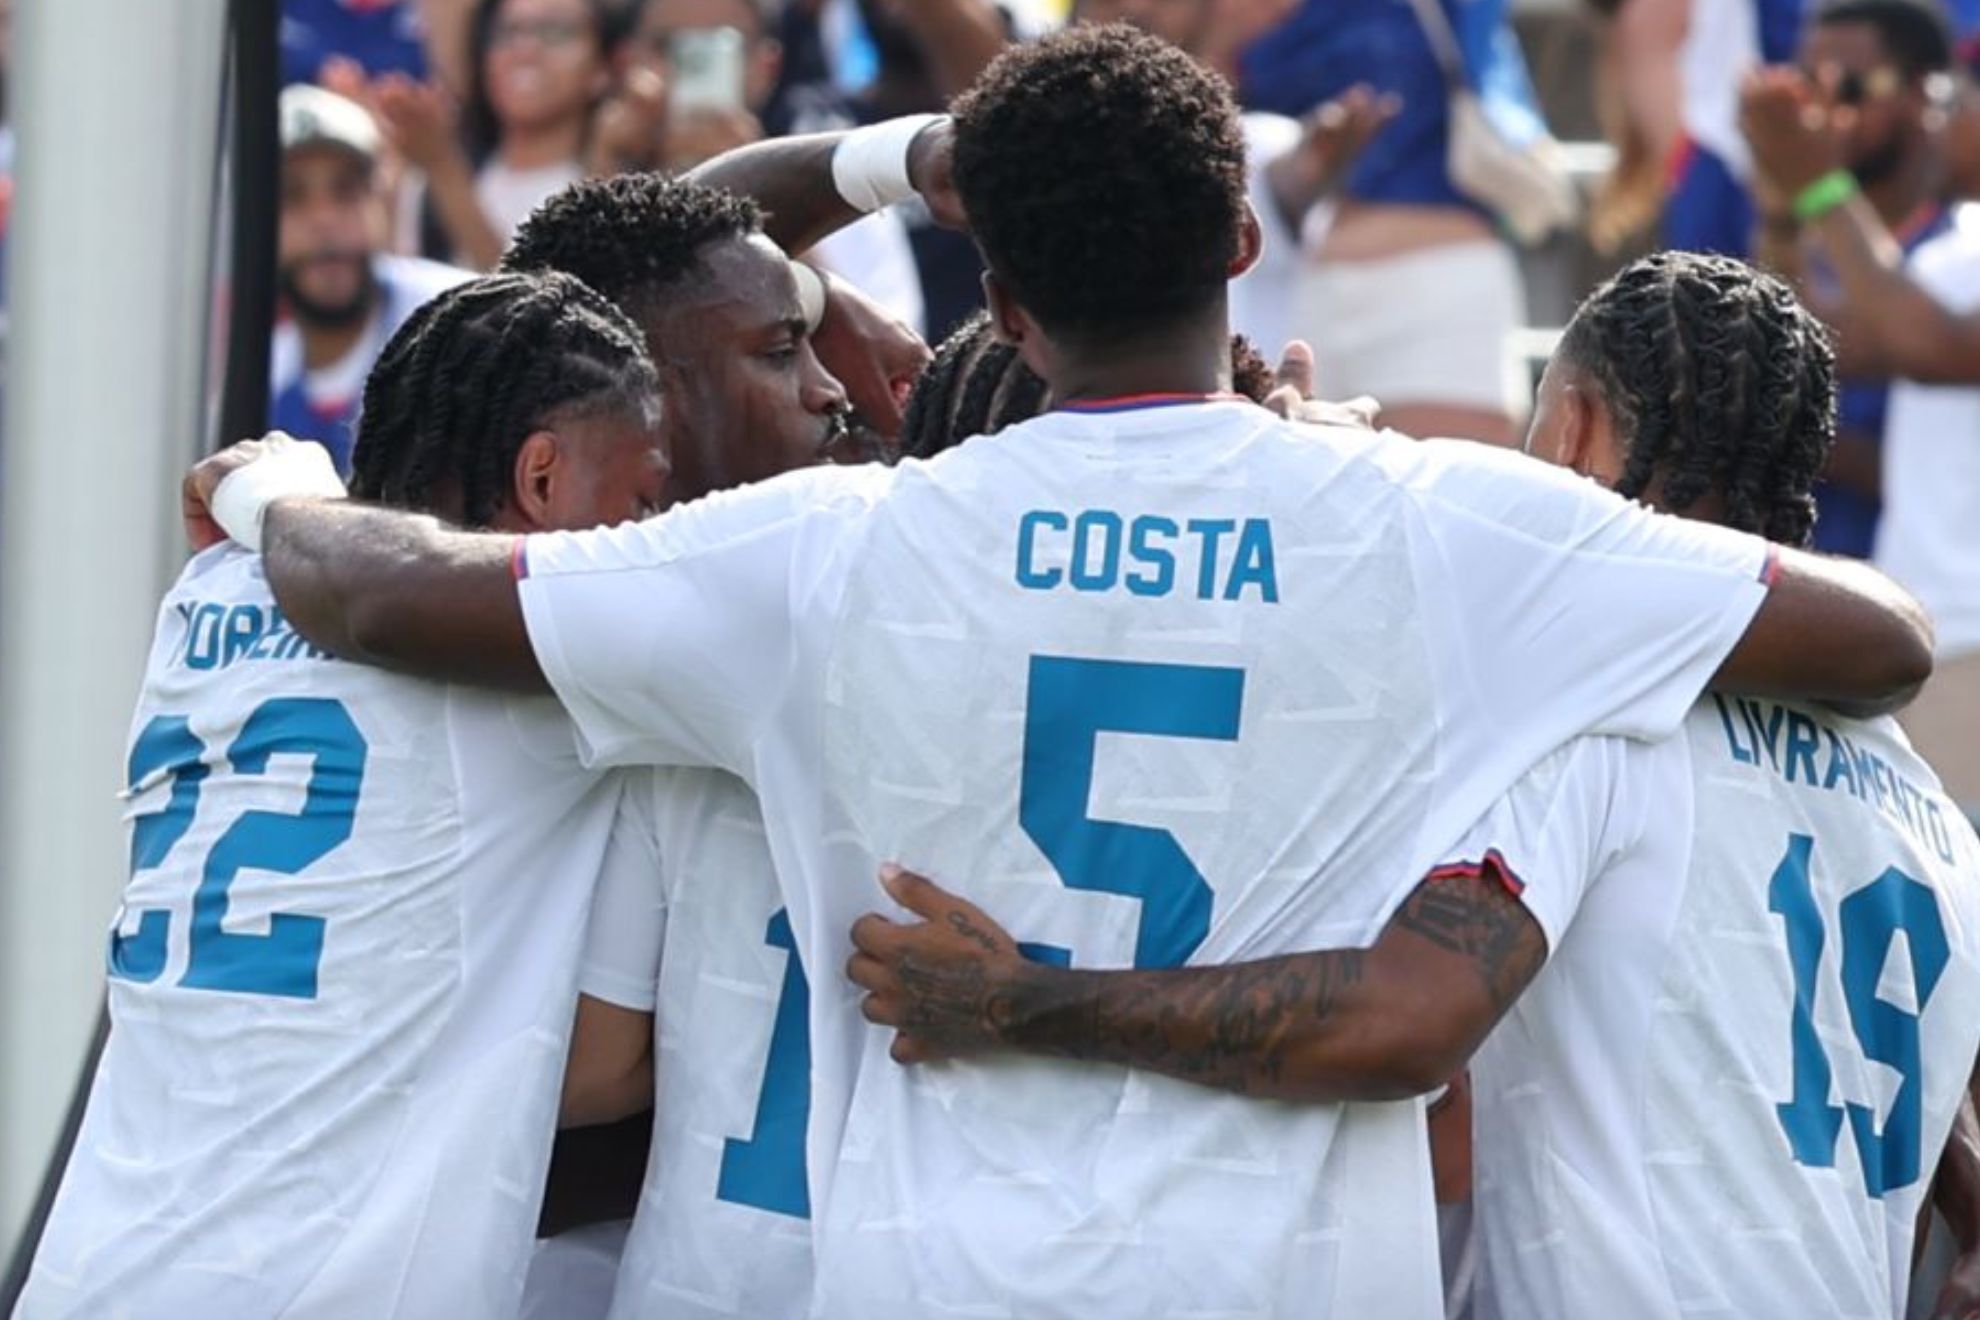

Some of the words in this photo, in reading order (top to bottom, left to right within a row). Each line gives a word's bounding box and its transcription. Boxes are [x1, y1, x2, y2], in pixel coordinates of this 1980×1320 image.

[1015, 508, 1279, 603] COSTA
[108, 696, 369, 1000] 22
[1019, 653, 1246, 968] 5
[1714, 693, 1955, 866] LIVRAMENTO
[1767, 832, 1951, 1199] 19
